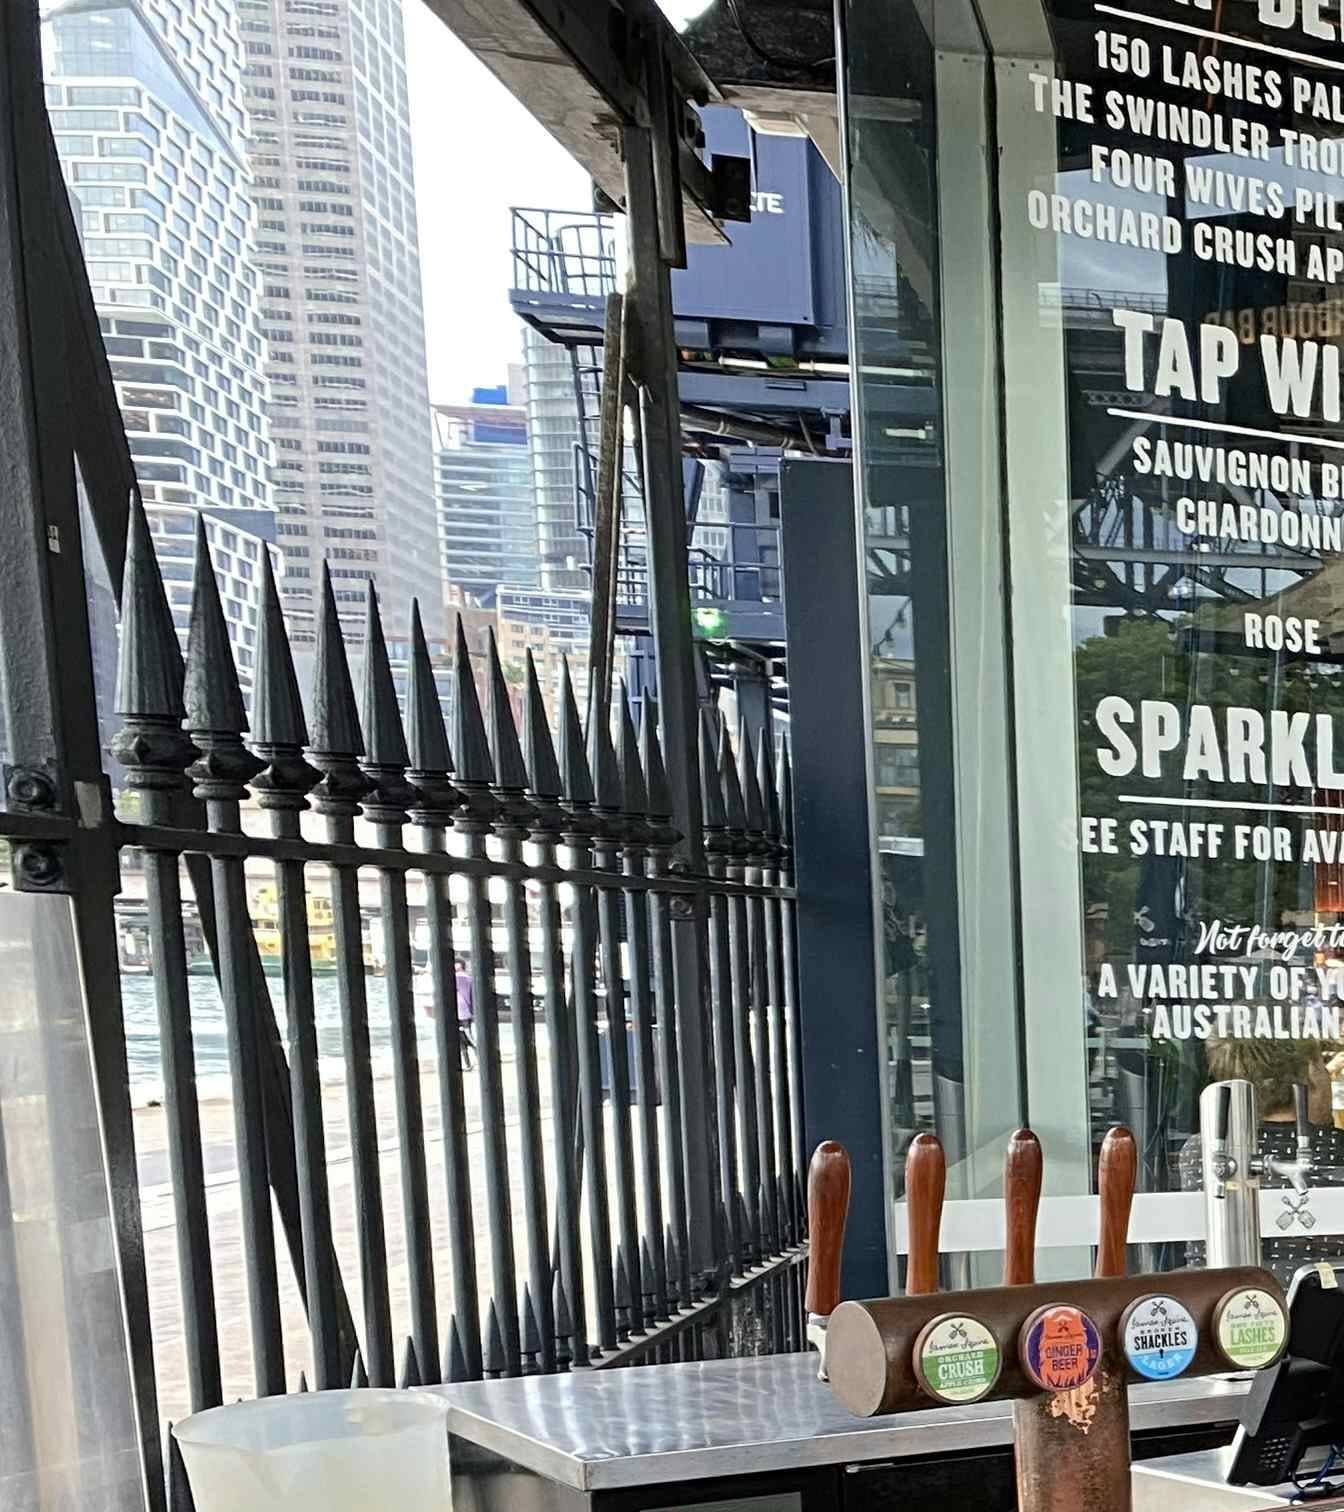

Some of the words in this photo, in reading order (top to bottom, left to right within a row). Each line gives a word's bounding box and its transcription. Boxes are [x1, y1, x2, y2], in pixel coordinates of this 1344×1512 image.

[1095, 30, 1150, 78] 150
[1163, 45, 1281, 108] LASHES
[1028, 72, 1094, 124] THE
[1105, 90, 1269, 161] SWINDLER
[1091, 144, 1176, 197] FOUR
[1185, 164, 1284, 219] WIVES
[1027, 190, 1182, 254] ORCHARD
[1194, 222, 1296, 276] CRUSH
[1112, 308, 1239, 403] TAP
[1132, 436, 1311, 496] SAUVIGNON
[1244, 612, 1321, 655] ROSE
[1130, 819, 1224, 859] STAFF
[1234, 824, 1292, 863] FOR
[1194, 920, 1244, 955] Not
[1098, 963, 1118, 998] A
[1127, 963, 1257, 1000] VARIETY
[1270, 965, 1302, 999] OF
[1152, 1005, 1339, 1040] AUSTRALIAN
[1046, 1344, 1082, 1359] GINGER
[1134, 1331, 1187, 1351] SHACKLES
[1231, 1327, 1275, 1345] LASHES
[938, 1360, 985, 1380] CRUSH
[1052, 1358, 1078, 1371] BEER
